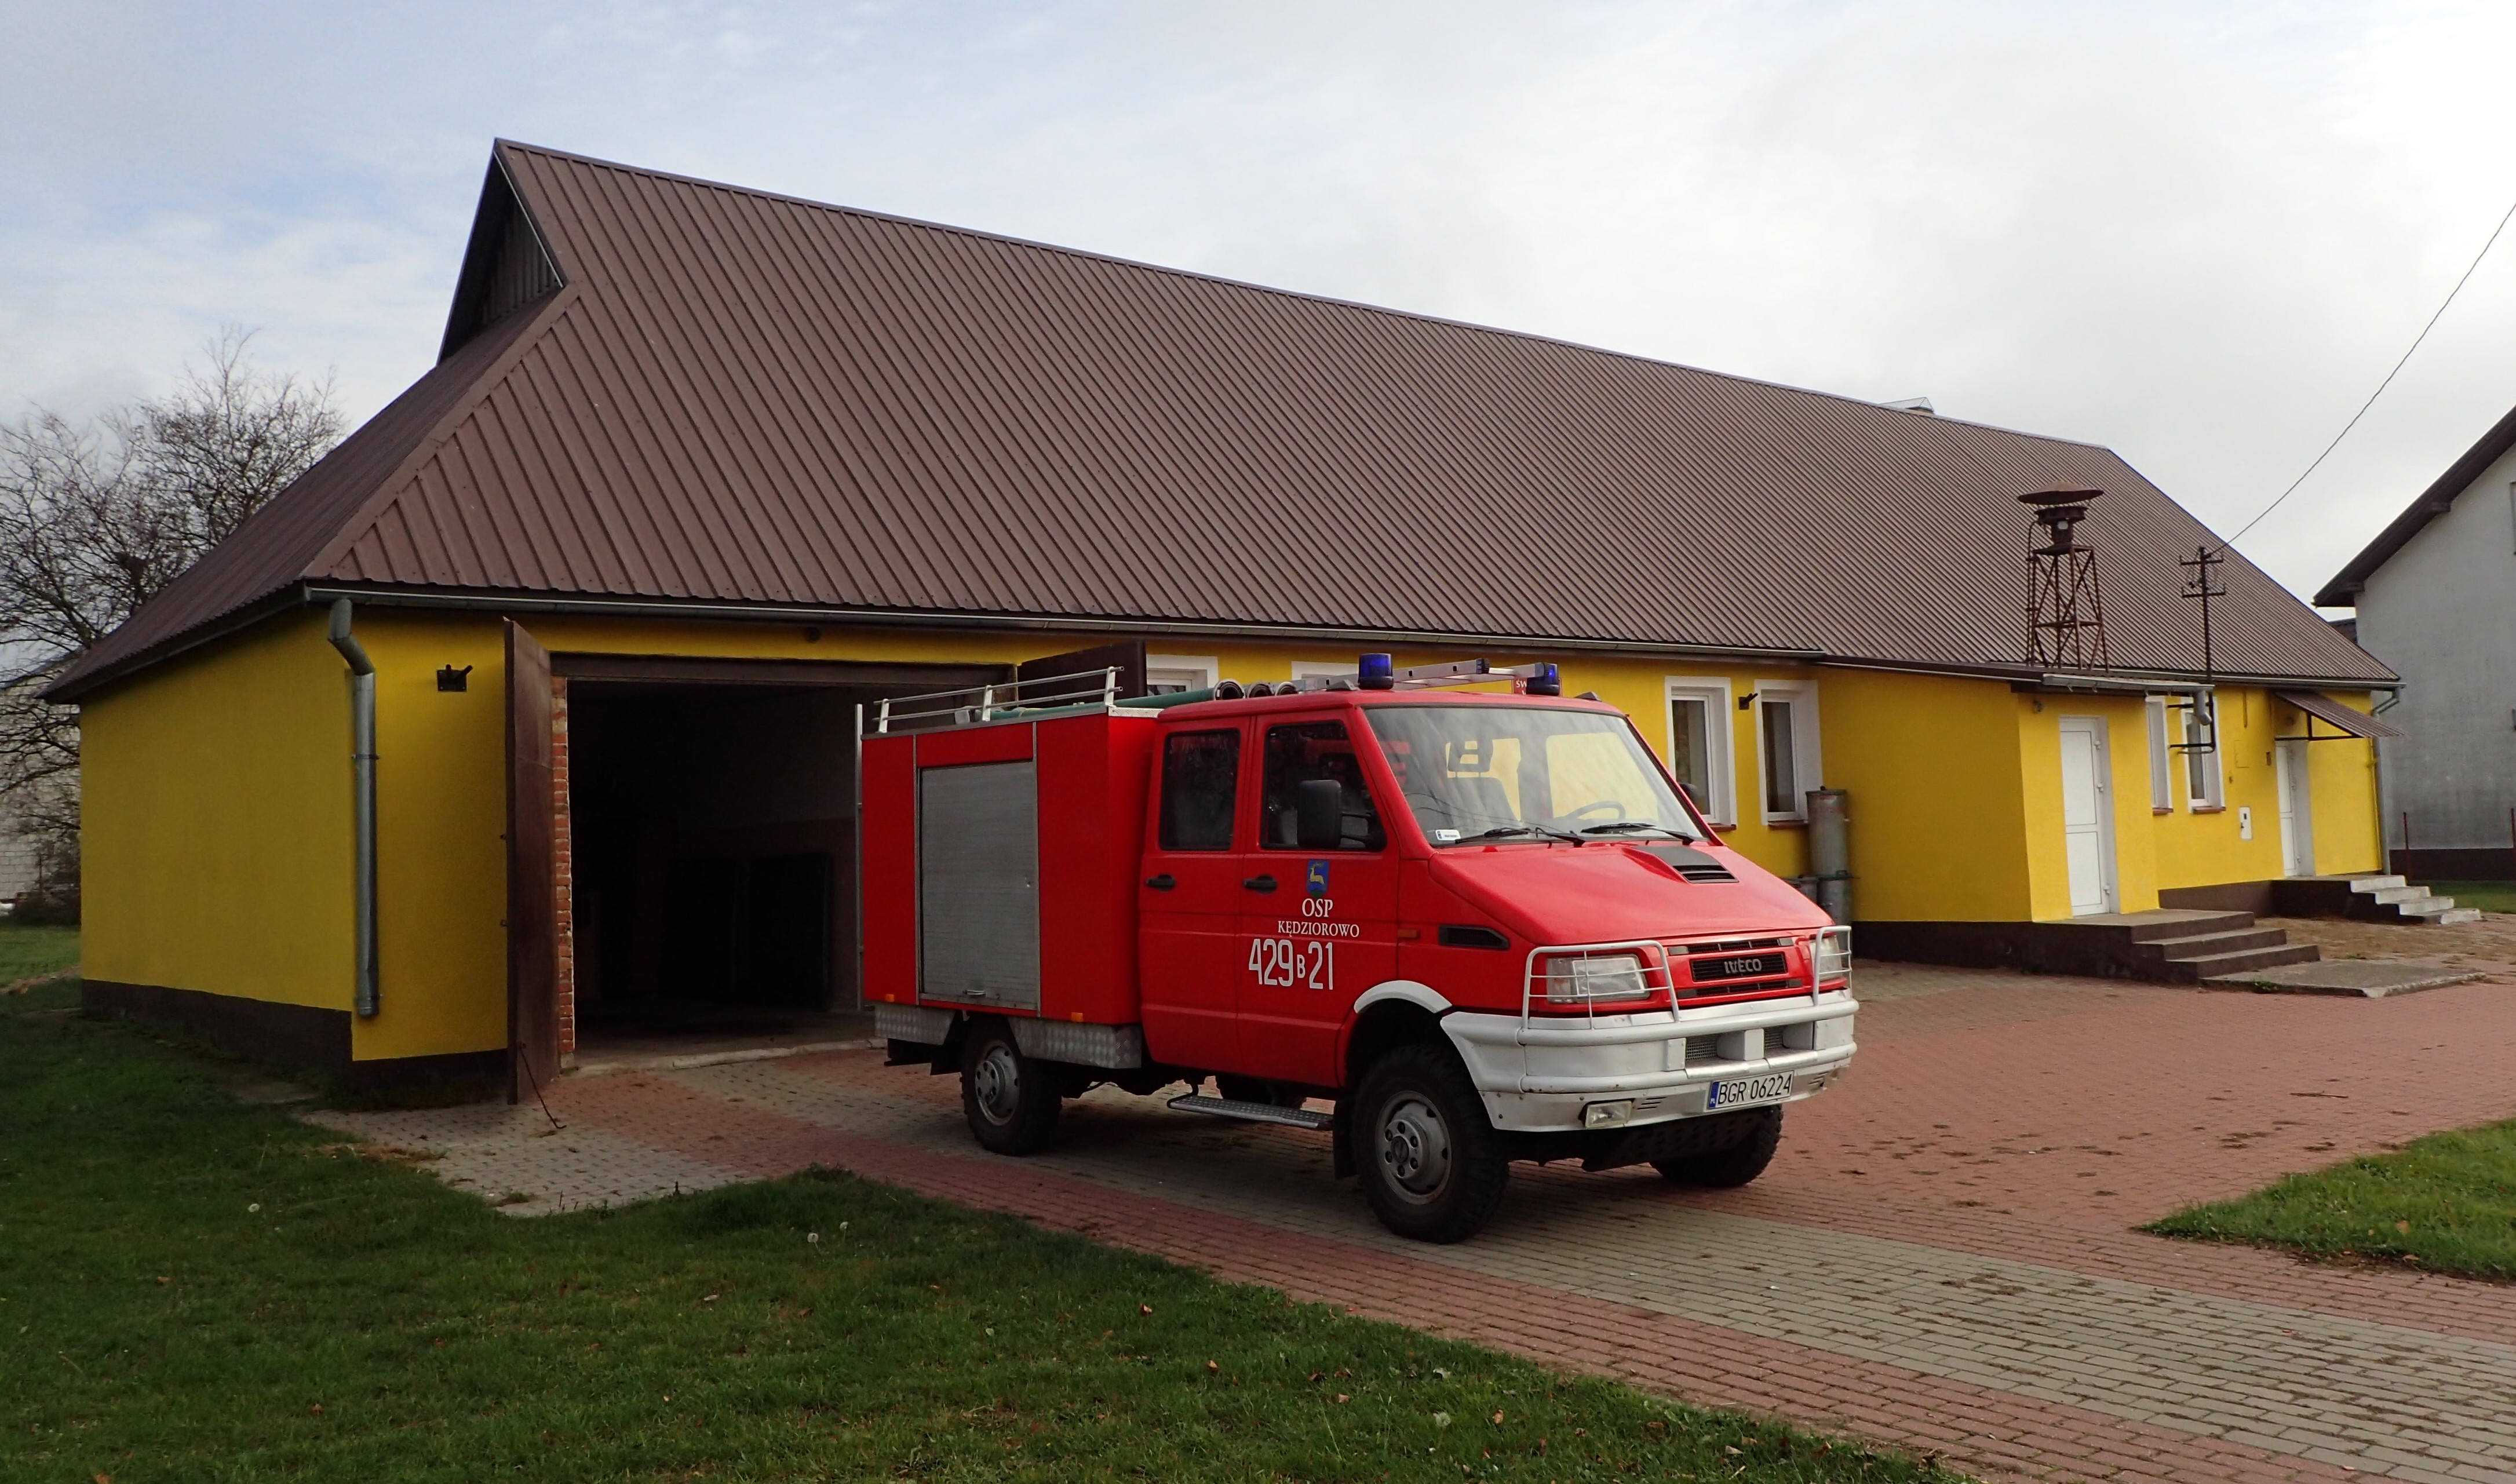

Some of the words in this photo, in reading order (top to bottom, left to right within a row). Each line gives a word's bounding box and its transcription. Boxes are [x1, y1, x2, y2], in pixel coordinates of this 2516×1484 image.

[1301, 898, 1333, 917] OSP
[1278, 920, 1360, 938] KĘDZIOROWO
[1724, 958, 1762, 973] IVECO
[1718, 1081, 1746, 1104] BGR
[1750, 1073, 1792, 1100] 06224
